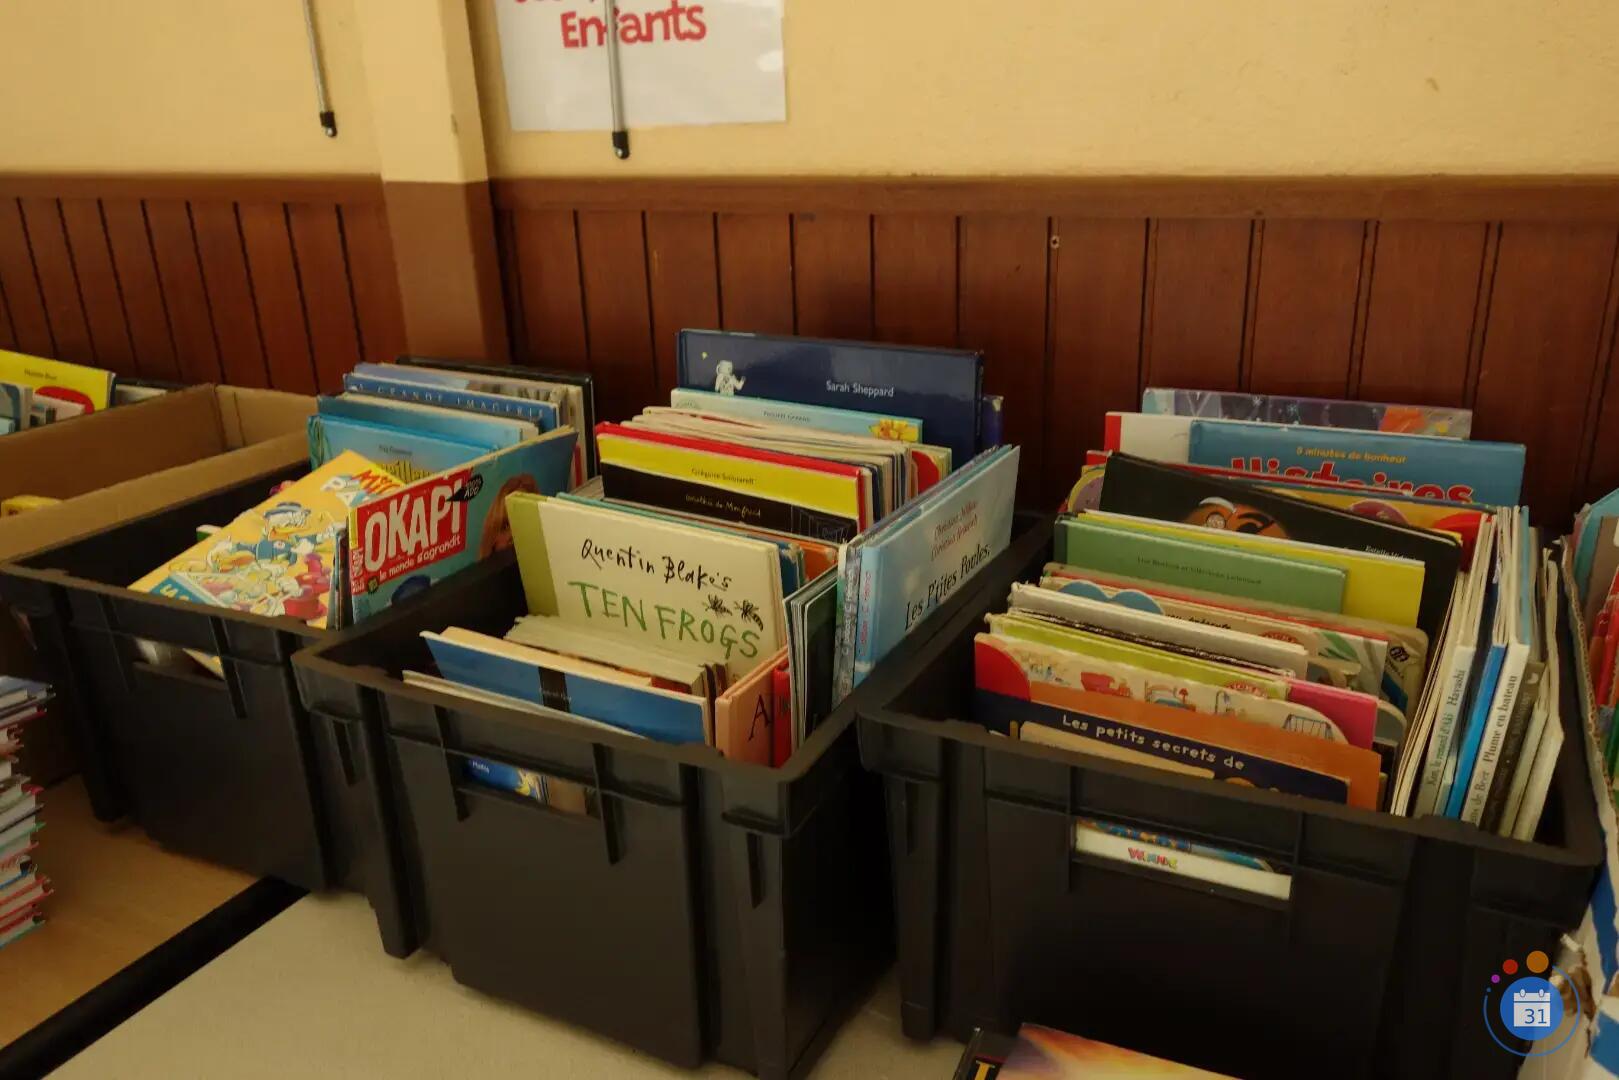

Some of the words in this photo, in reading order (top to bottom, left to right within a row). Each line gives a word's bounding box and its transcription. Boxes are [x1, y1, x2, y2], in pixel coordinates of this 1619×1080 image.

[377, 385, 443, 402] GRANDE
[826, 380, 850, 394] Sarah
[852, 382, 895, 398] Sheppard
[1305, 447, 1345, 461] minutes
[1346, 449, 1361, 460] de
[1362, 450, 1408, 463] bonheur
[389, 553, 415, 576] monde
[581, 537, 655, 574] Quentin
[662, 555, 732, 592] Blake's
[904, 600, 923, 632] Les
[927, 570, 957, 609] P'tites
[567, 580, 648, 632] TEN
[655, 604, 761, 660] FROGS
[1447, 669, 1465, 706] Hayashi
[1500, 675, 1518, 711] bateau
[1495, 713, 1506, 728] en
[1063, 714, 1089, 731] Les
[1096, 725, 1146, 746] petits
[1151, 739, 1217, 763] secrets
[1223, 753, 1245, 771] de
[1483, 730, 1501, 762] Plume
